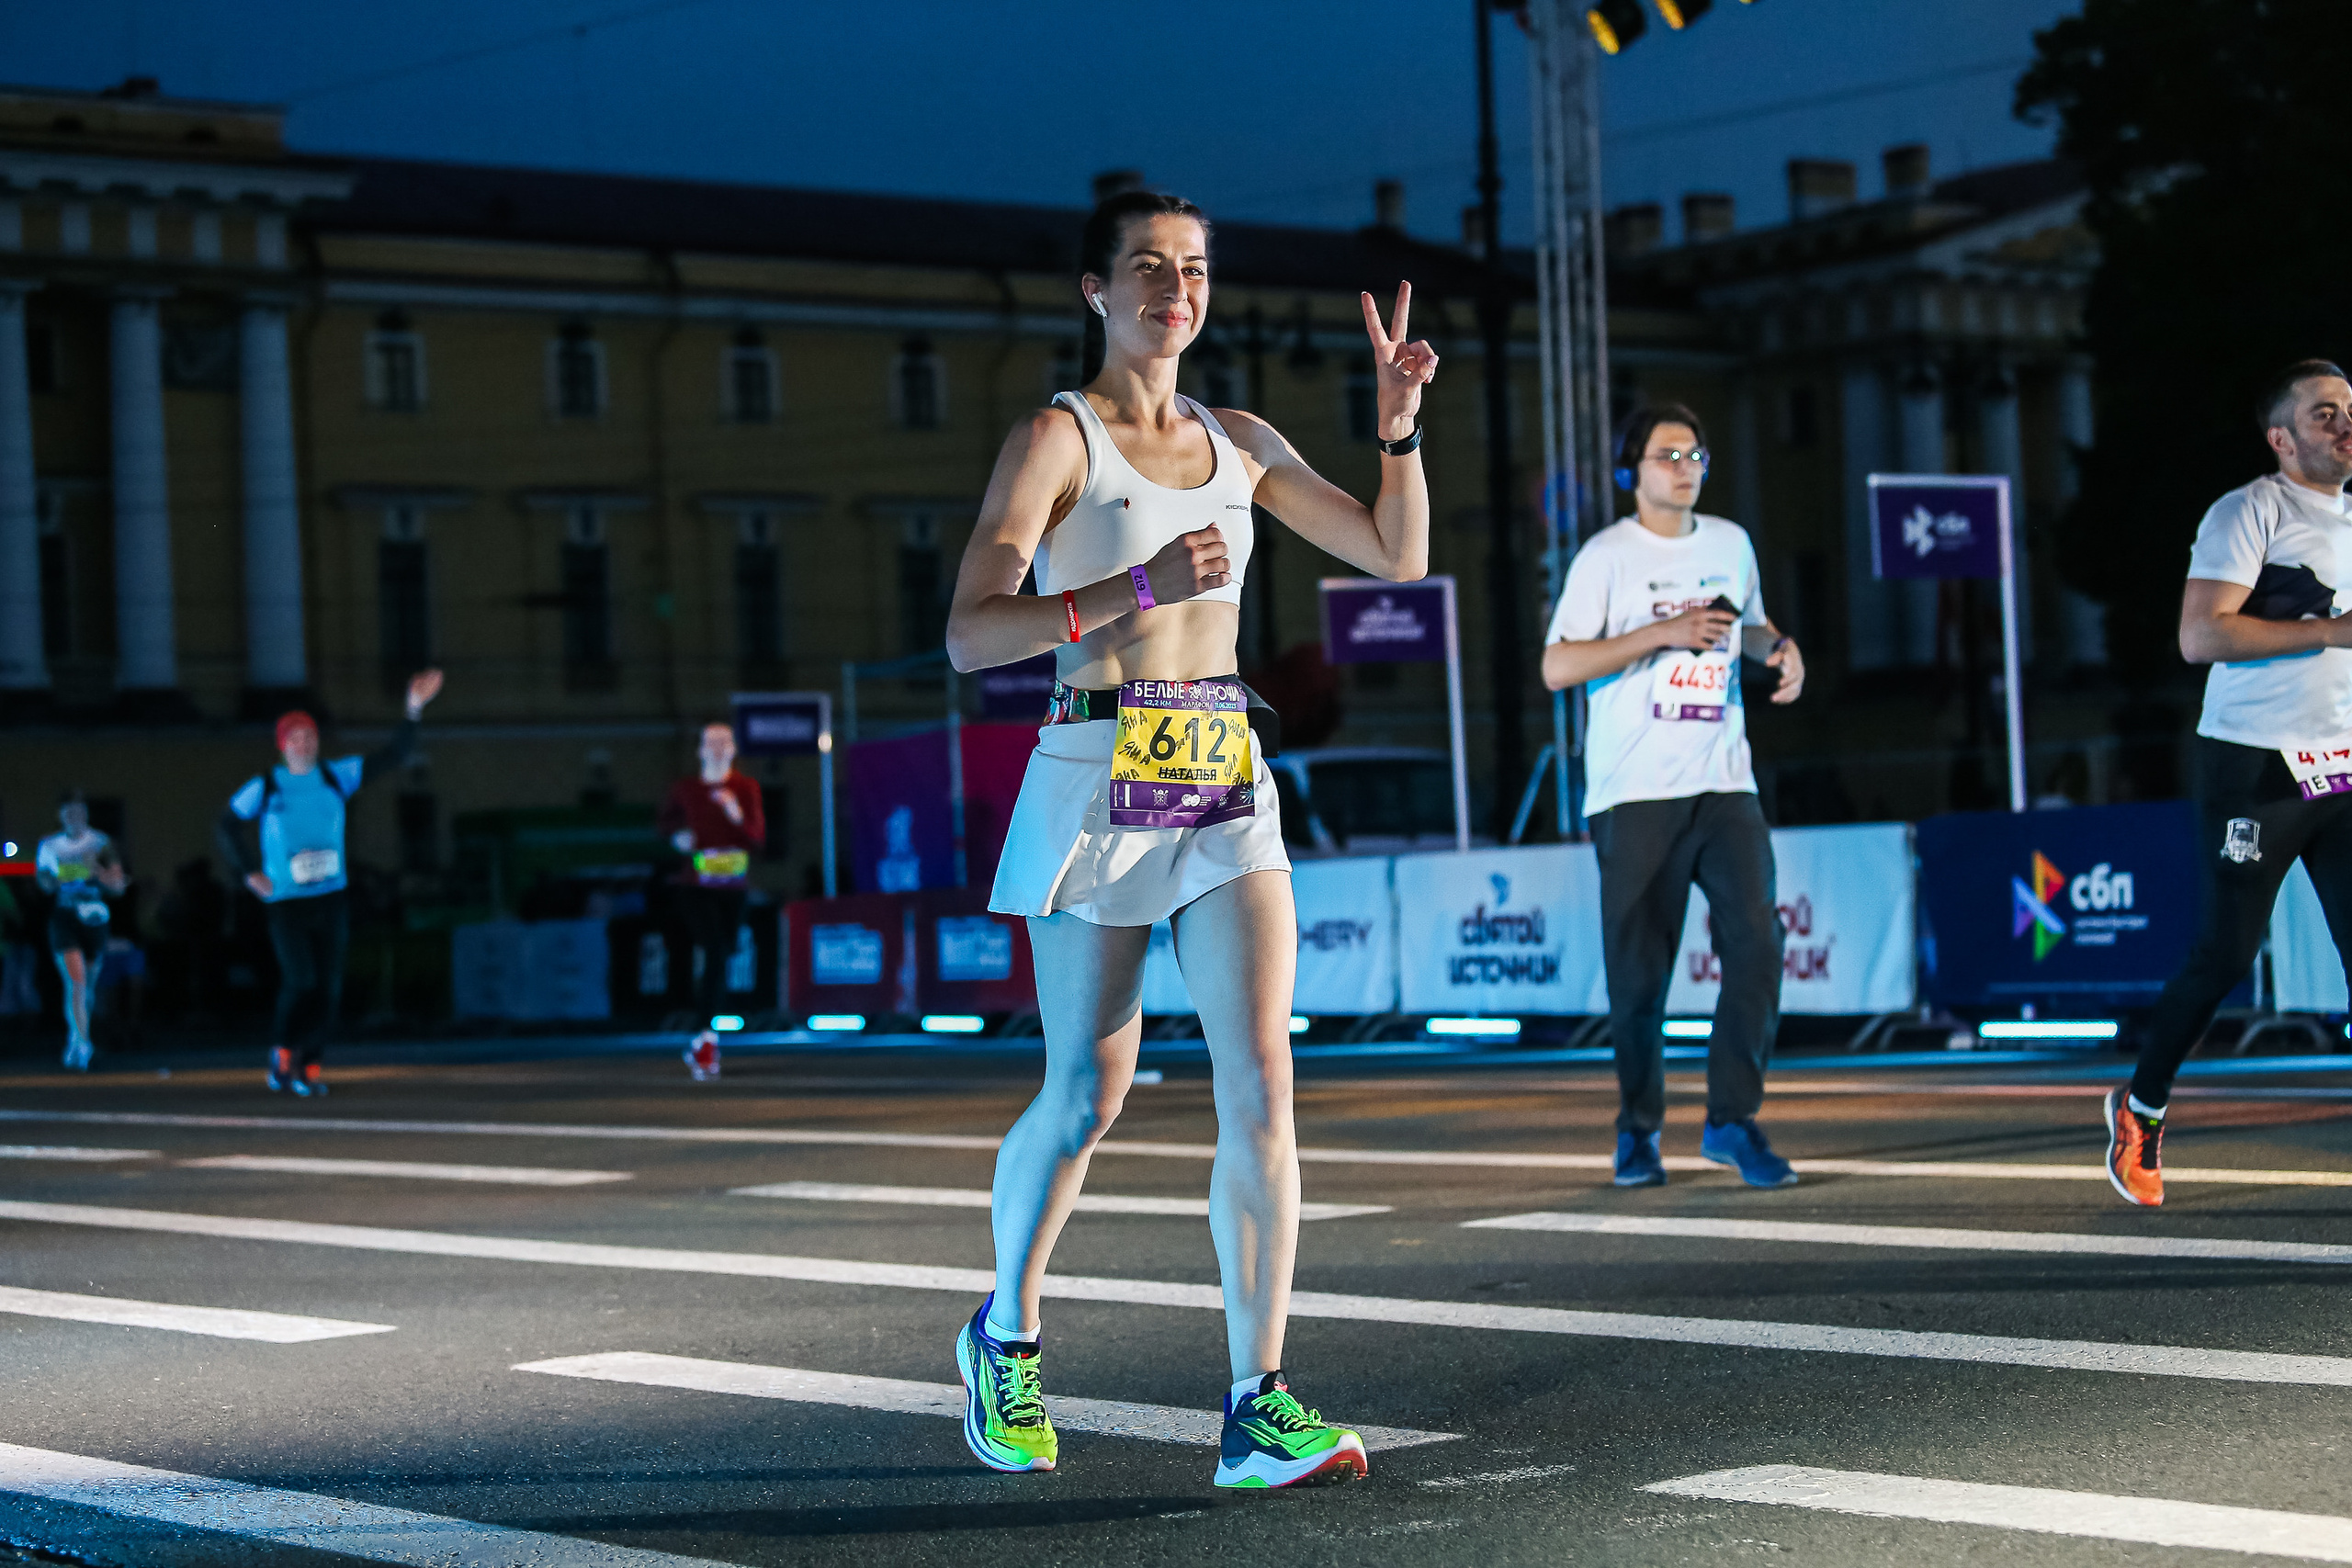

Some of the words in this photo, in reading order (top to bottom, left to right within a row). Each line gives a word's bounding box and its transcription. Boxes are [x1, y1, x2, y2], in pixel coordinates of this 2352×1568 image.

[1134, 573, 1146, 592] 612
[1134, 682, 1185, 699] БЕЛЫЕ
[1206, 684, 1240, 702] НОЧИ
[1181, 700, 1210, 708] МАРАФОН
[1149, 716, 1226, 763] 612
[1158, 766, 1217, 781] НАТАЛЬЯ
[1297, 919, 1374, 952] HERY
